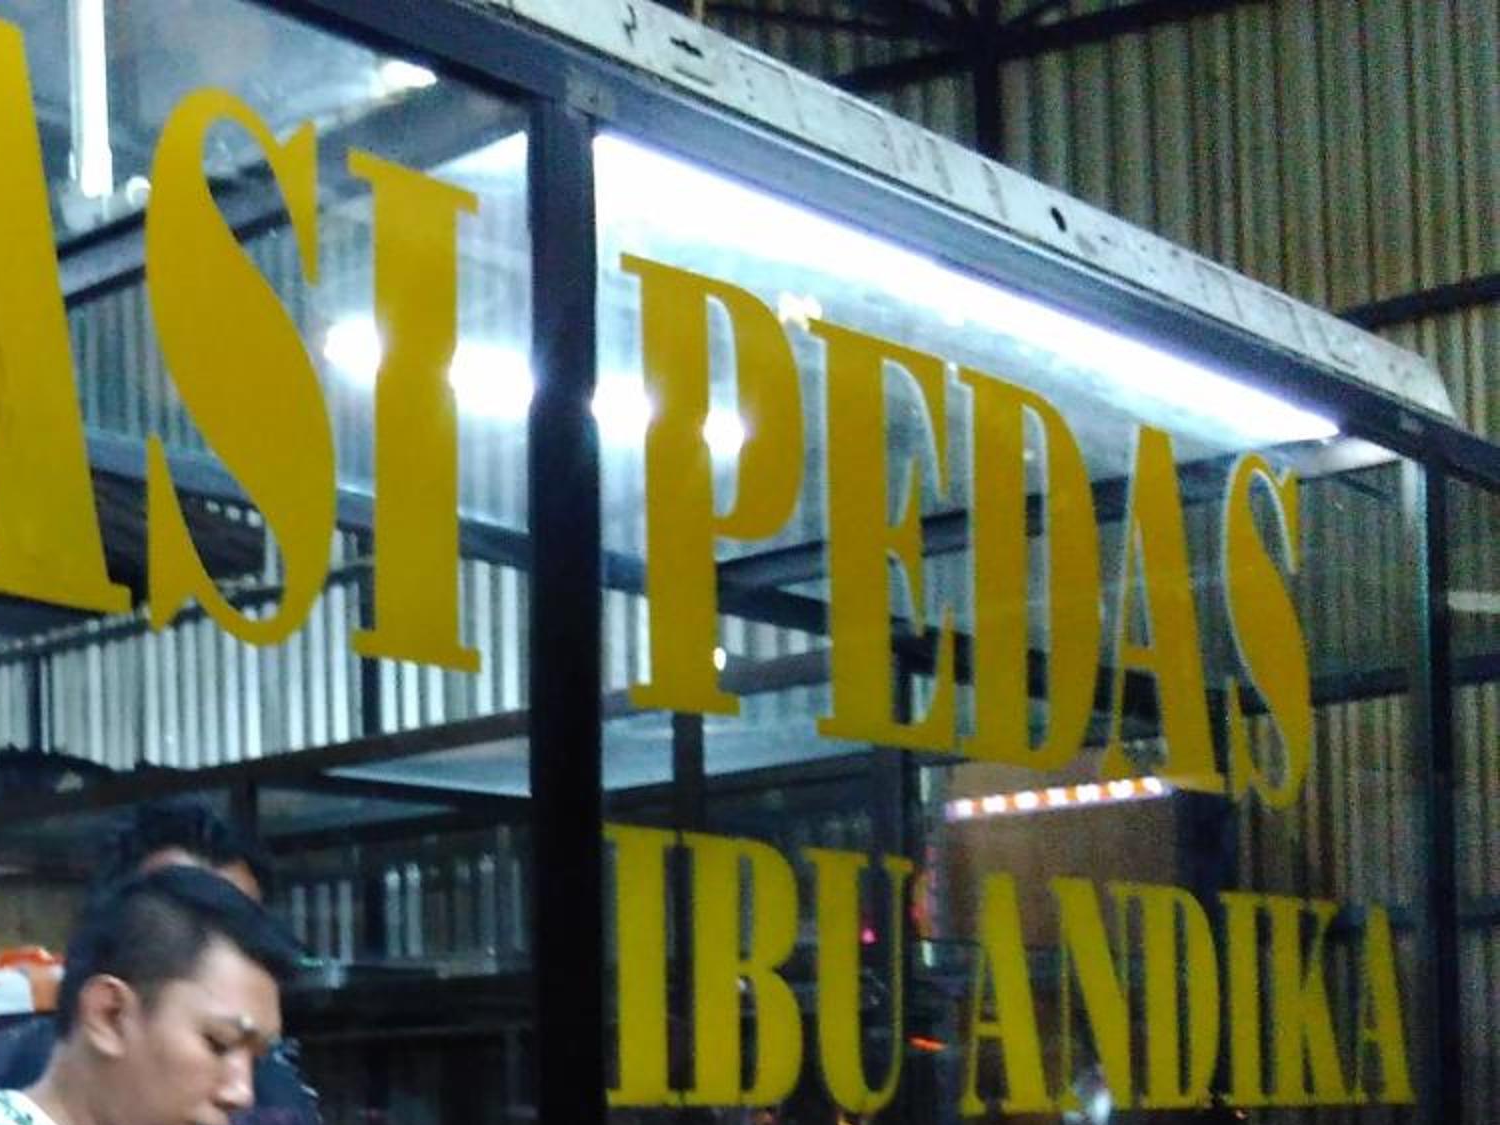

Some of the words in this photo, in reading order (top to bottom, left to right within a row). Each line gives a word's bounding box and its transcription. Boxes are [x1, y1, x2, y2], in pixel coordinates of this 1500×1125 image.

[620, 253, 1313, 810] PEDAS
[604, 822, 913, 1115] IBU
[961, 871, 1417, 1117] ANDIKA
